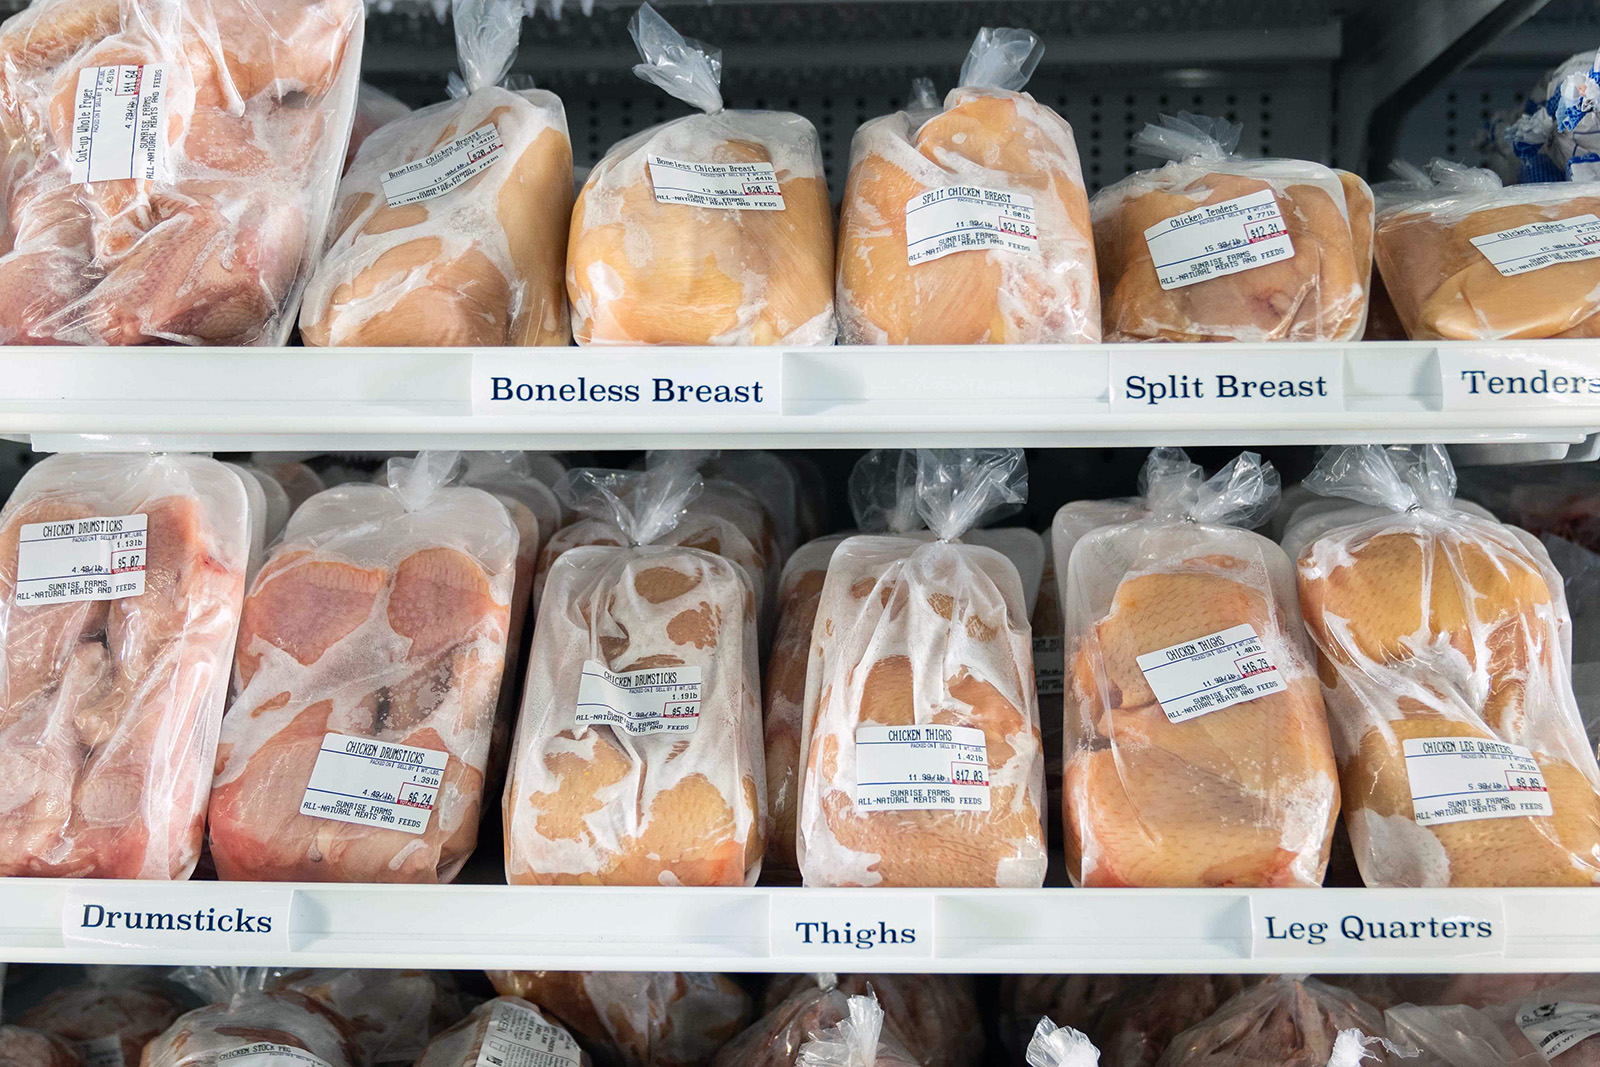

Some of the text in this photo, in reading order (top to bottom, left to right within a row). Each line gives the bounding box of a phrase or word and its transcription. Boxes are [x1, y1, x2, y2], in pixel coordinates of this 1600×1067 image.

[153, 69, 162, 88] FEEDS
[76, 89, 95, 163] Cut-up Whole Fryer
[140, 96, 151, 148] SUNRISE FARMS
[150, 107, 158, 128] MEATS
[146, 133, 156, 179] ALL-NATURAL
[389, 163, 423, 179] Boneless
[426, 146, 453, 164] Chicken
[456, 132, 480, 146] Breast
[656, 158, 691, 170] Boneless
[923, 187, 1011, 204] SPLIT CHICKEN BREAST
[1170, 212, 1203, 228] Chicken
[1206, 204, 1238, 217] Tenders
[1003, 222, 1030, 235] $21.58
[1251, 224, 1280, 238] $12.31
[1497, 229, 1530, 240] Chicken
[1532, 224, 1565, 232] Tenders
[938, 233, 970, 245] SUNRISE
[909, 242, 957, 261] ALL-NATURAL
[1008, 242, 1030, 251] FEEDS
[1161, 268, 1212, 285] ALL-NATURAL
[1215, 262, 1238, 270] MEATS
[1261, 248, 1285, 259] FEEDS
[1191, 251, 1250, 271] SUNRISE FARMS
[491, 377, 763, 403] Boneless Breast
[1125, 374, 1328, 405] Split Breast
[1461, 370, 1600, 395] Tenders
[43, 524, 74, 537] CHICKEN
[79, 520, 123, 534] DRUMSTICKS
[118, 555, 139, 569] $5.07
[17, 588, 66, 600] ALL-NATURAL
[71, 587, 93, 595] MEATS
[116, 583, 136, 592] FEEDS
[49, 582, 79, 590] SUNRISE
[1166, 644, 1197, 661] CHICKEN
[1198, 636, 1225, 651] THIGHS
[1242, 658, 1269, 673] $16.79
[604, 671, 677, 687] CHICKEN DRUMSTICKS
[1168, 681, 1278, 719] ALL-NATURAL MEATS AND FEEDS
[1193, 684, 1247, 704] SUNRISE FARMS
[672, 706, 694, 716] $5.94
[888, 729, 952, 741] CHICKEN THIGHS
[346, 741, 425, 764] CHICKEN DRUMSTICKS
[1422, 741, 1513, 754] CHICKEN LEG QUARTERS
[958, 753, 983, 761] 1.42lb
[412, 775, 438, 785] 1.39lb
[956, 770, 983, 782] $17.03
[336, 800, 392, 815] SUNRISE FARMS
[408, 792, 432, 806] $6.24
[859, 796, 909, 805] ALL-NATURAL
[1448, 799, 1480, 808] SUNRISE
[303, 802, 421, 828] ALL-NATURAL MEATS AND FEEDS
[1416, 806, 1468, 820] ALL-NATURAL
[1473, 804, 1496, 813] MEATS
[1501, 802, 1516, 810] AND
[81, 904, 272, 933] Drumsticks
[796, 922, 915, 949] Thighs
[1265, 915, 1492, 945] Leg Quarters
[220, 1047, 249, 1059] CHICKEN
[253, 1044, 275, 1052] STOCK
[1547, 1042, 1561, 1055] NET
